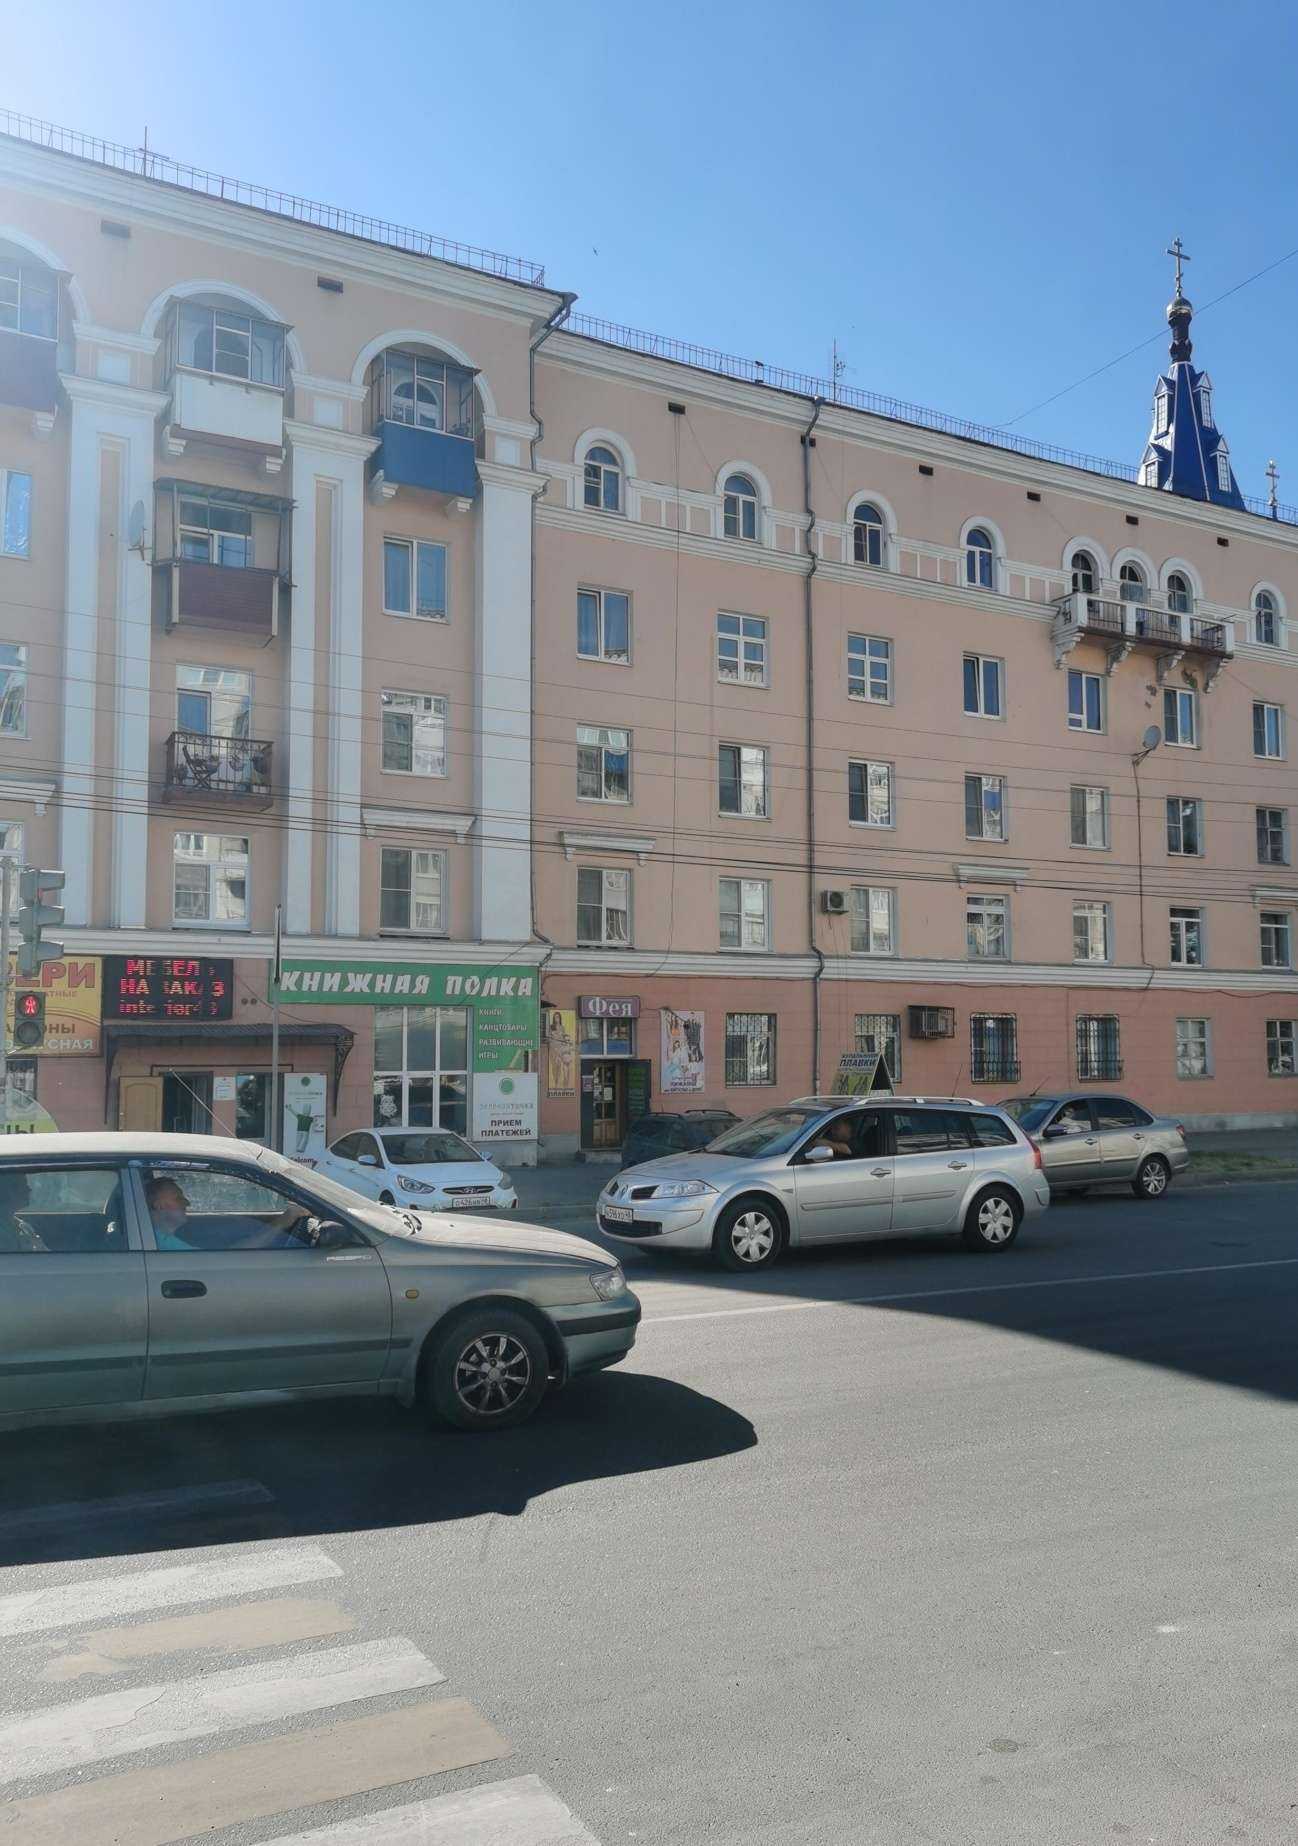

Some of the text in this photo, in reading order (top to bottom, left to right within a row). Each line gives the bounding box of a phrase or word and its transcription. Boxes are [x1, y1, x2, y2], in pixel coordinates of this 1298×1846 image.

[280, 971, 533, 996] КНИЖНАЯ ПОЛКА
[588, 996, 633, 1017] Фея
[490, 1119, 522, 1127] ПРИЕМ
[480, 1127, 532, 1137] ПЛАТЕЖЕЙ
